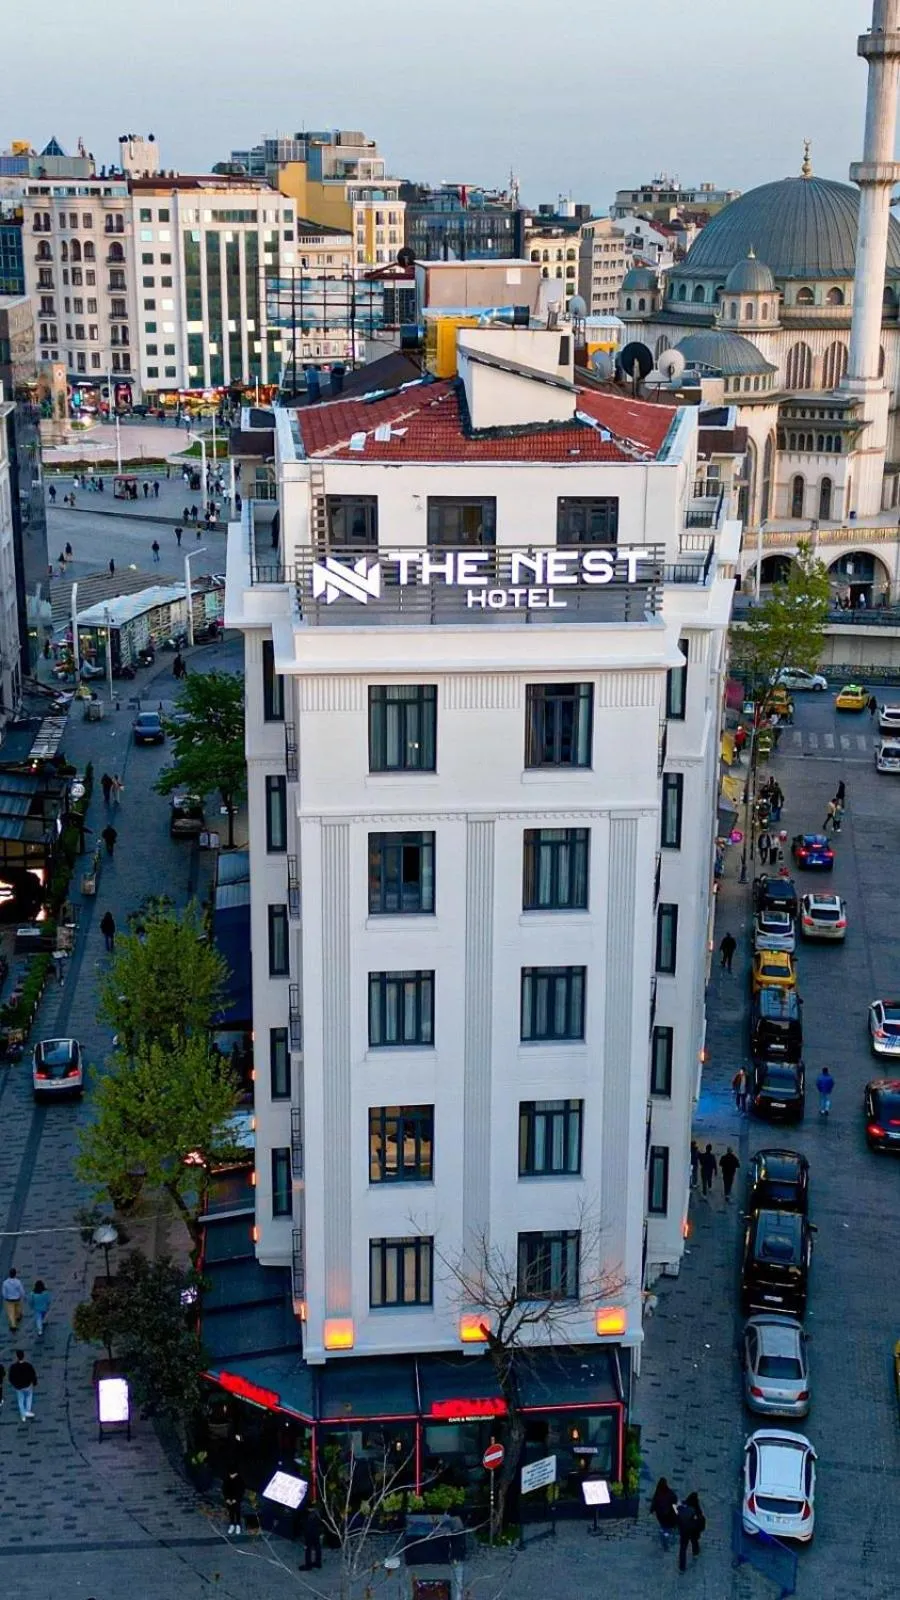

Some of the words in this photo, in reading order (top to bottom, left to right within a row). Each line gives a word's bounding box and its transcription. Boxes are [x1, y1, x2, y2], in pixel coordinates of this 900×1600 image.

[388, 553, 488, 584] THE
[512, 551, 648, 584] NEST
[467, 588, 567, 607] HOTEL
